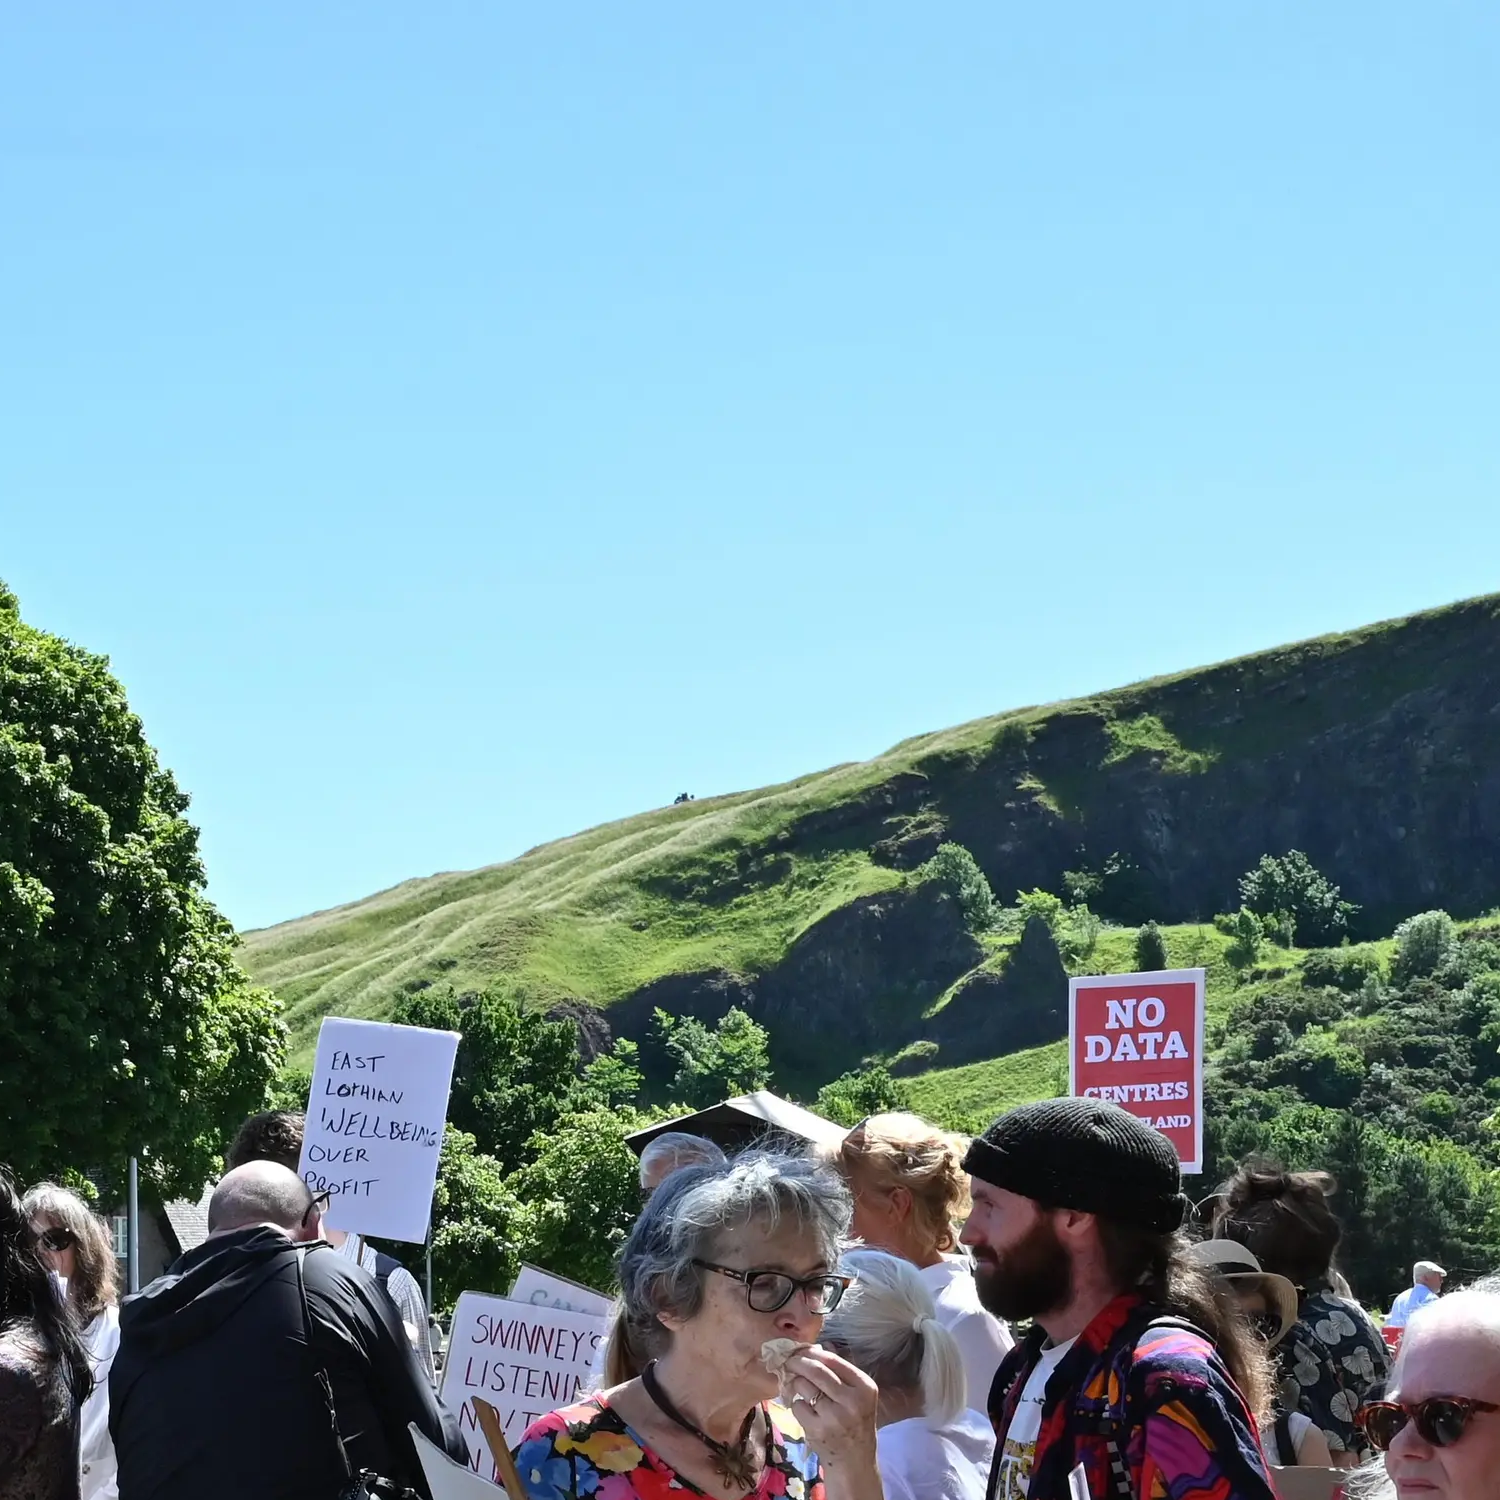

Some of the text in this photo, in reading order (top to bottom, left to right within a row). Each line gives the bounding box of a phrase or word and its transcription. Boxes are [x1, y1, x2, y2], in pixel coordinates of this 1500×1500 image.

[1105, 997, 1165, 1030] NO
[1084, 1031, 1188, 1064] DATA
[331, 1051, 385, 1072] EAST
[1083, 1081, 1189, 1104] CENTRES
[321, 1107, 438, 1147] WELLBEING
[309, 1144, 370, 1163] OVER
[304, 1171, 380, 1196] PROFIT
